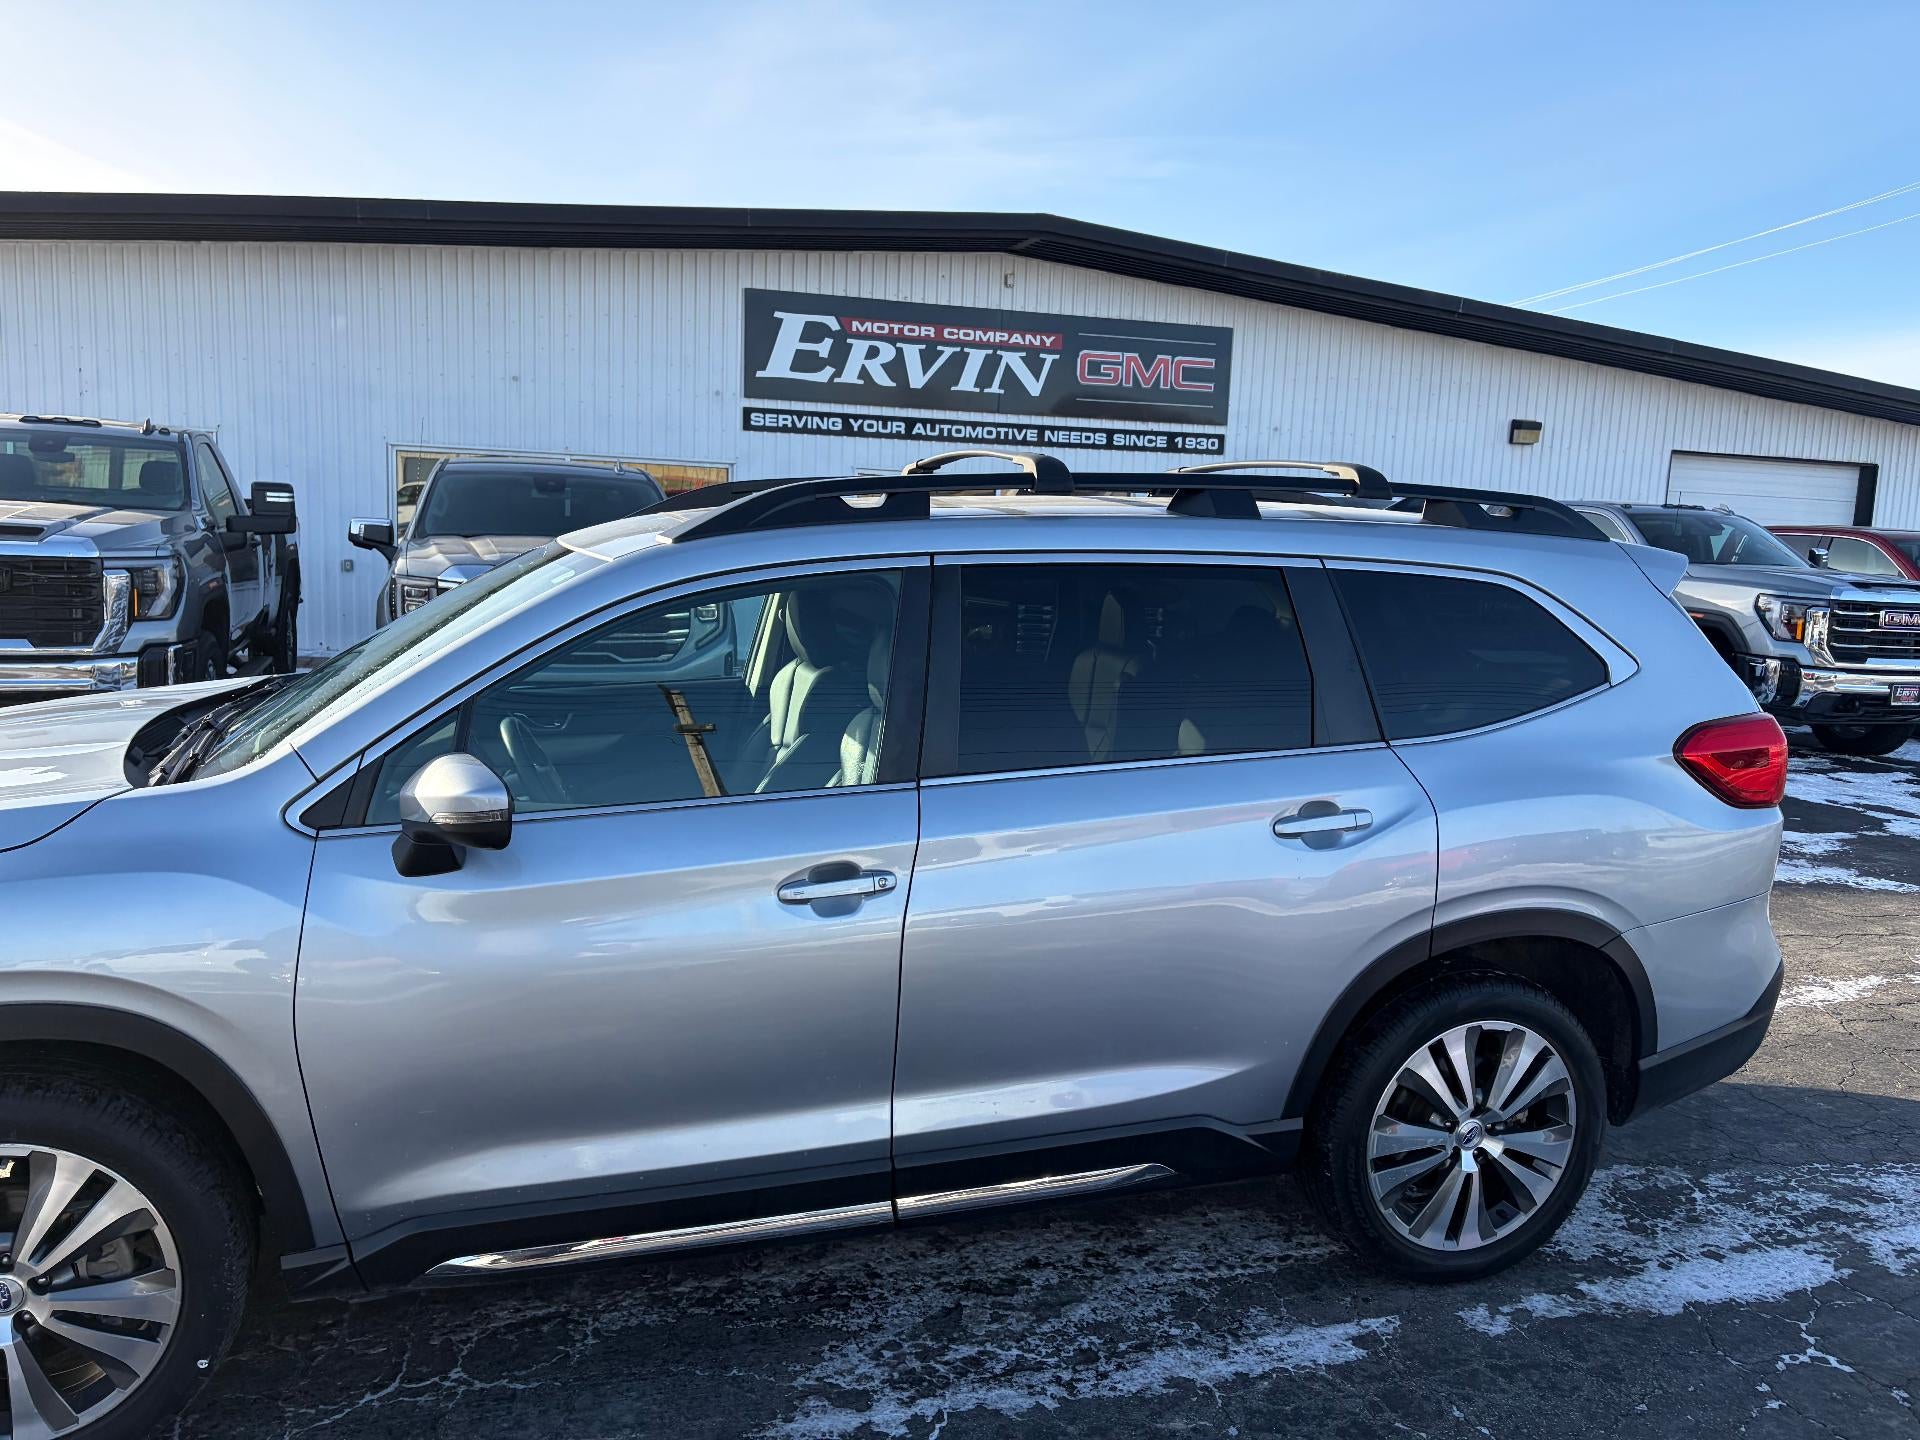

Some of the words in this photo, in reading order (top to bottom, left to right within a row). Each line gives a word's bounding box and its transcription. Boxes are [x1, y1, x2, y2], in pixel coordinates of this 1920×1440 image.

[851, 320, 936, 338] MOTOR
[943, 328, 1056, 347] COMPANY
[756, 311, 1060, 397] ERVIN
[1076, 350, 1216, 392] GMC
[750, 412, 843, 431] SERVING
[849, 418, 906, 435] YOUR
[912, 422, 1038, 442] AUTOMOTIVE
[1044, 430, 1107, 446] NEEDS
[1112, 433, 1168, 448] SINCE
[1174, 437, 1219, 450] 1930
[1885, 612, 1920, 626] GM
